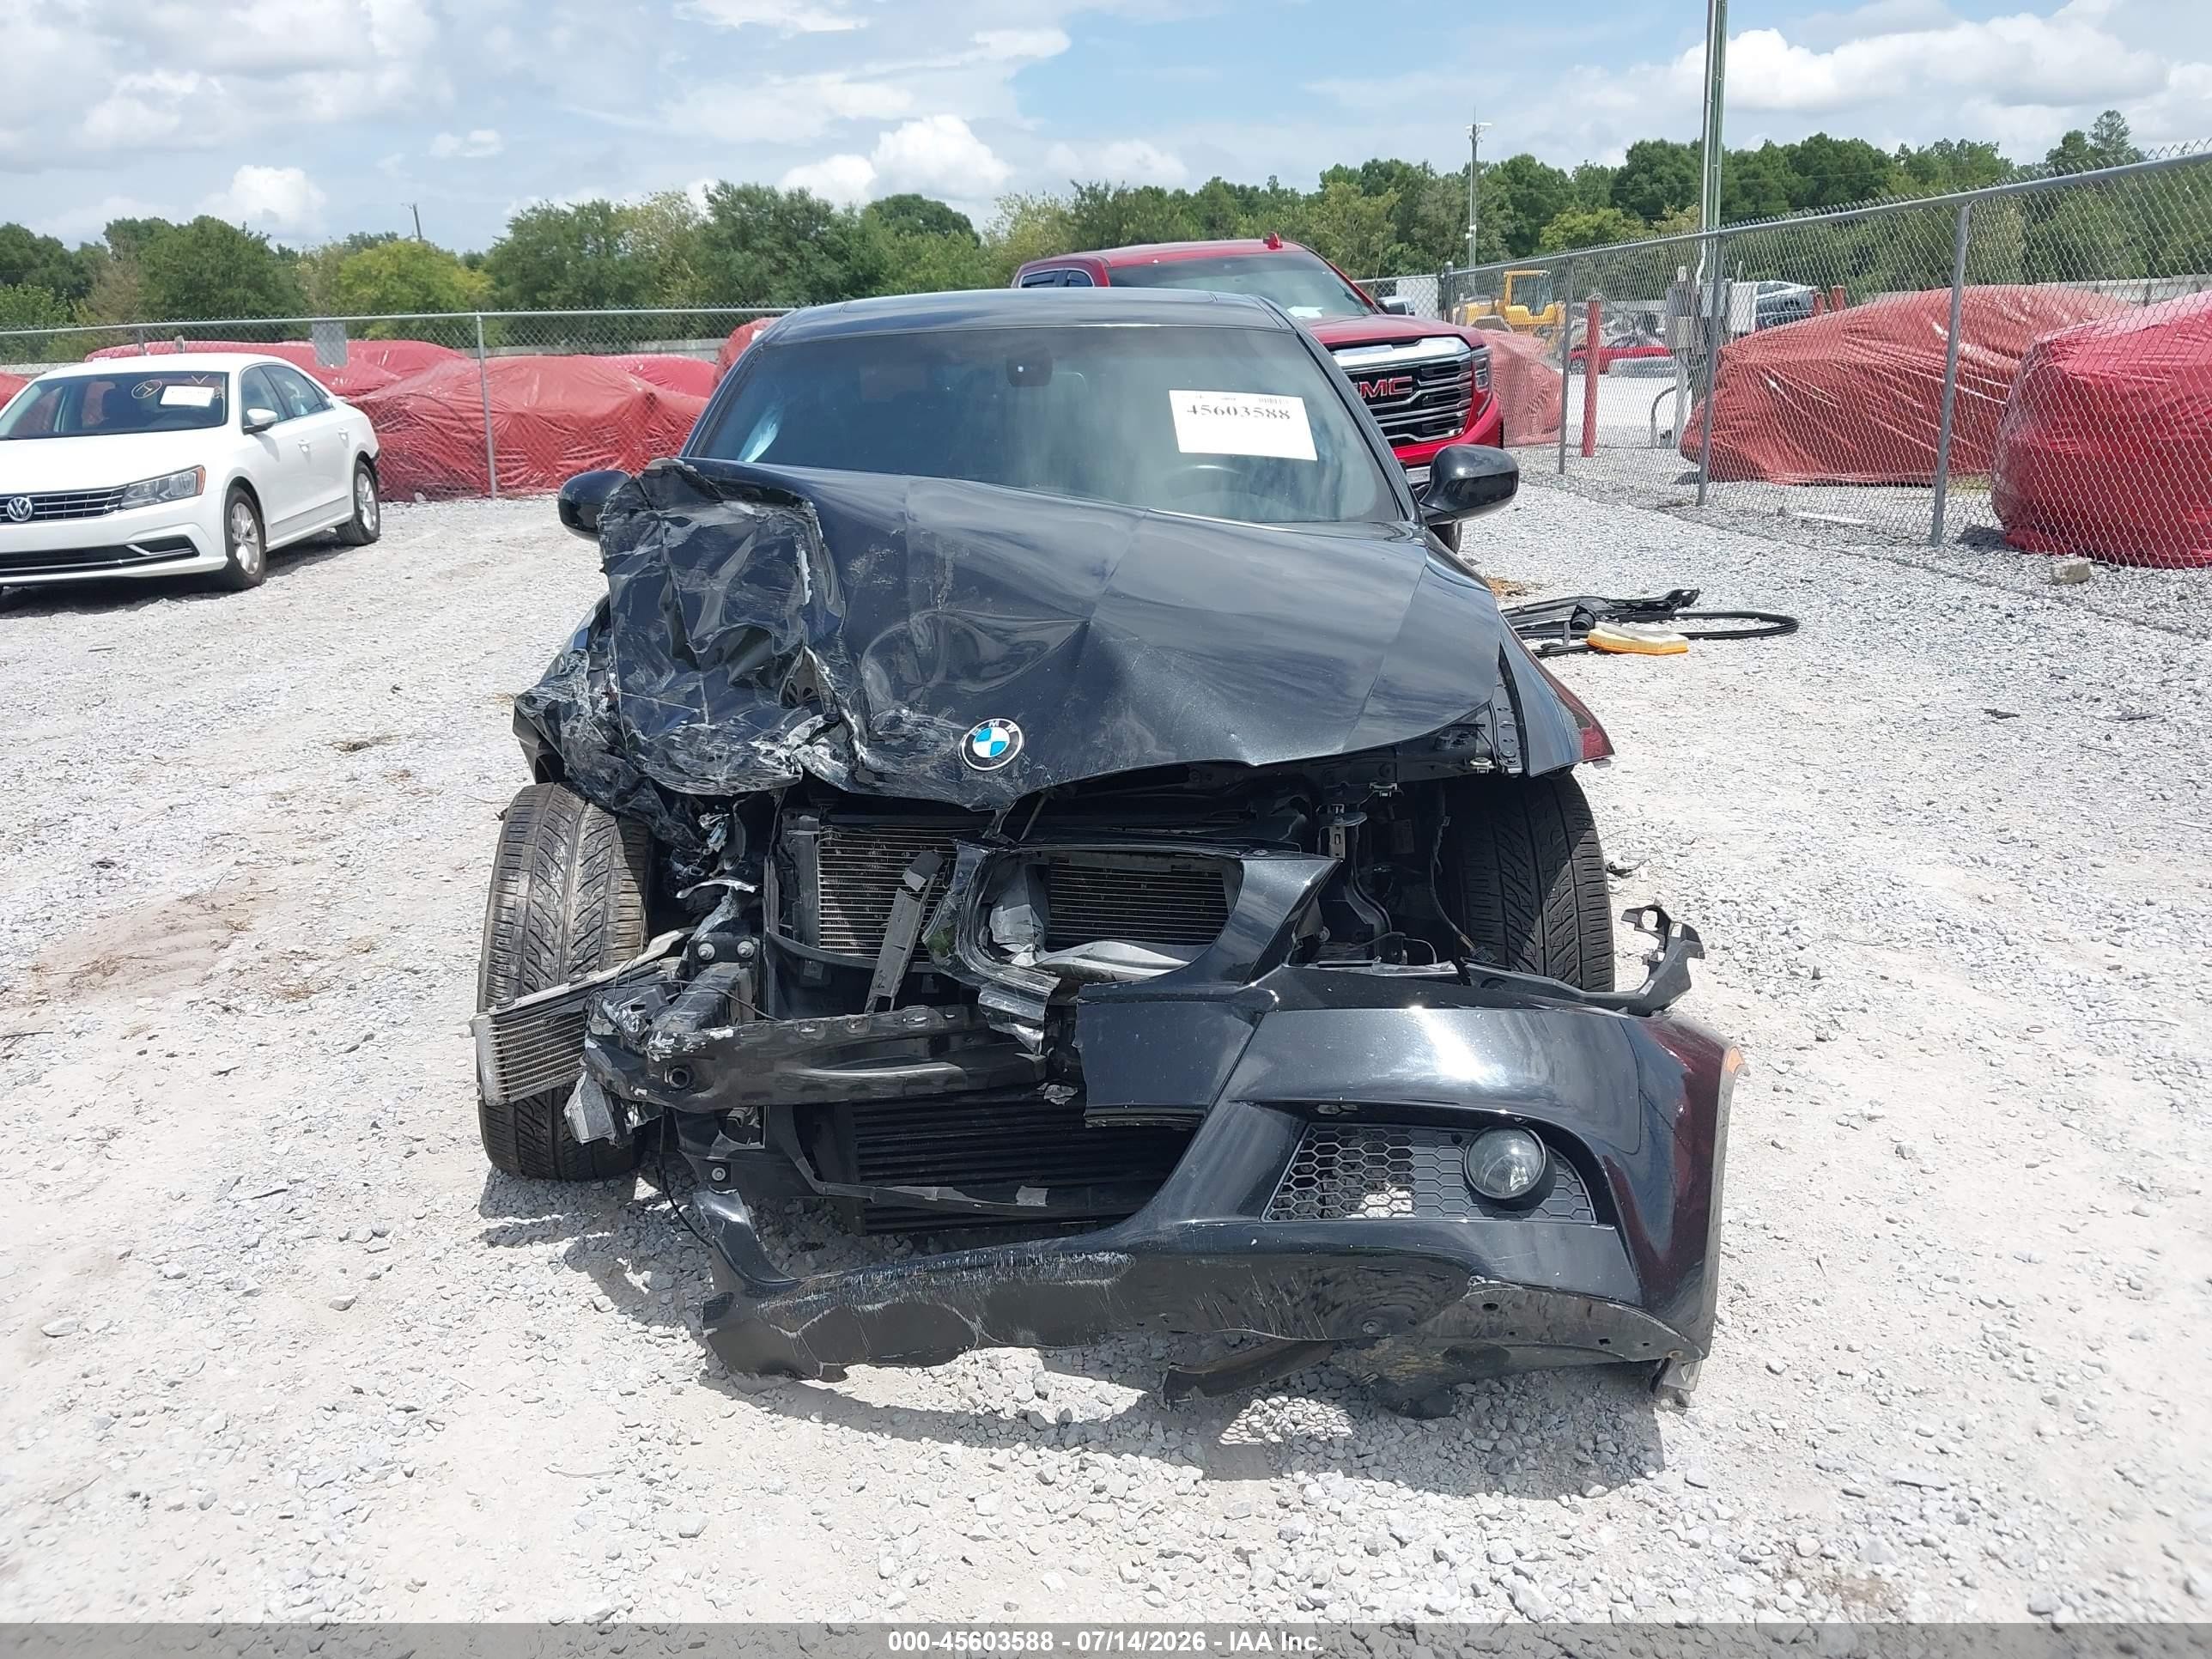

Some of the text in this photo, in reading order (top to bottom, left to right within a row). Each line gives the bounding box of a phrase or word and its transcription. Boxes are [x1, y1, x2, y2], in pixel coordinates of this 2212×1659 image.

[1353, 375, 1413, 399] MC
[1187, 404, 1291, 420] 45603588
[970, 720, 1018, 737] BMW
